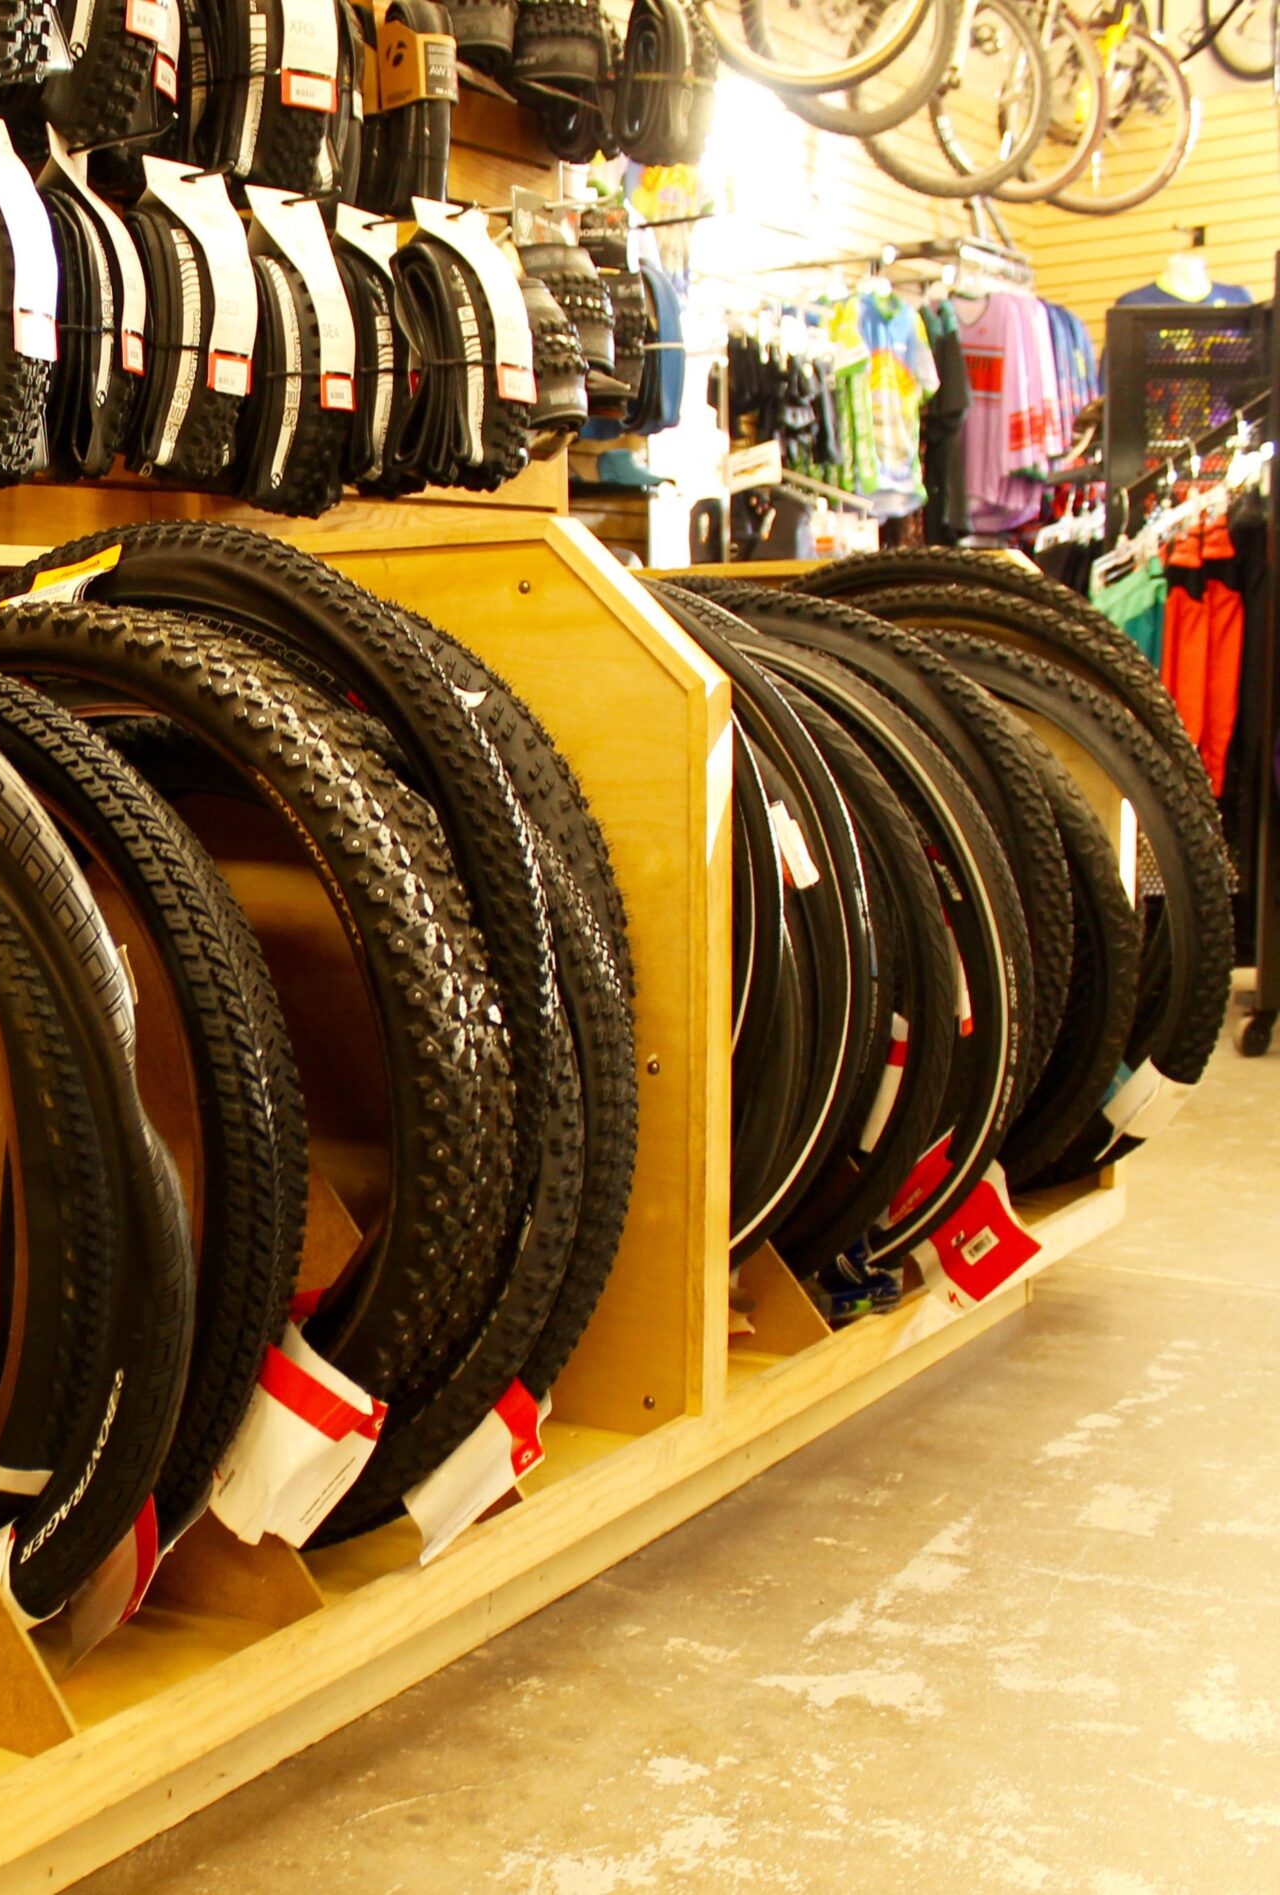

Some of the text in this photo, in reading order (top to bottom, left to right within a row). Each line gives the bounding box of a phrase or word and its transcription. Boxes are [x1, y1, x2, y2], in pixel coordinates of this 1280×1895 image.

[163, 387, 191, 442] SE3
[191, 308, 202, 347] issue
[20, 1387, 120, 1564] BONTRAGER
